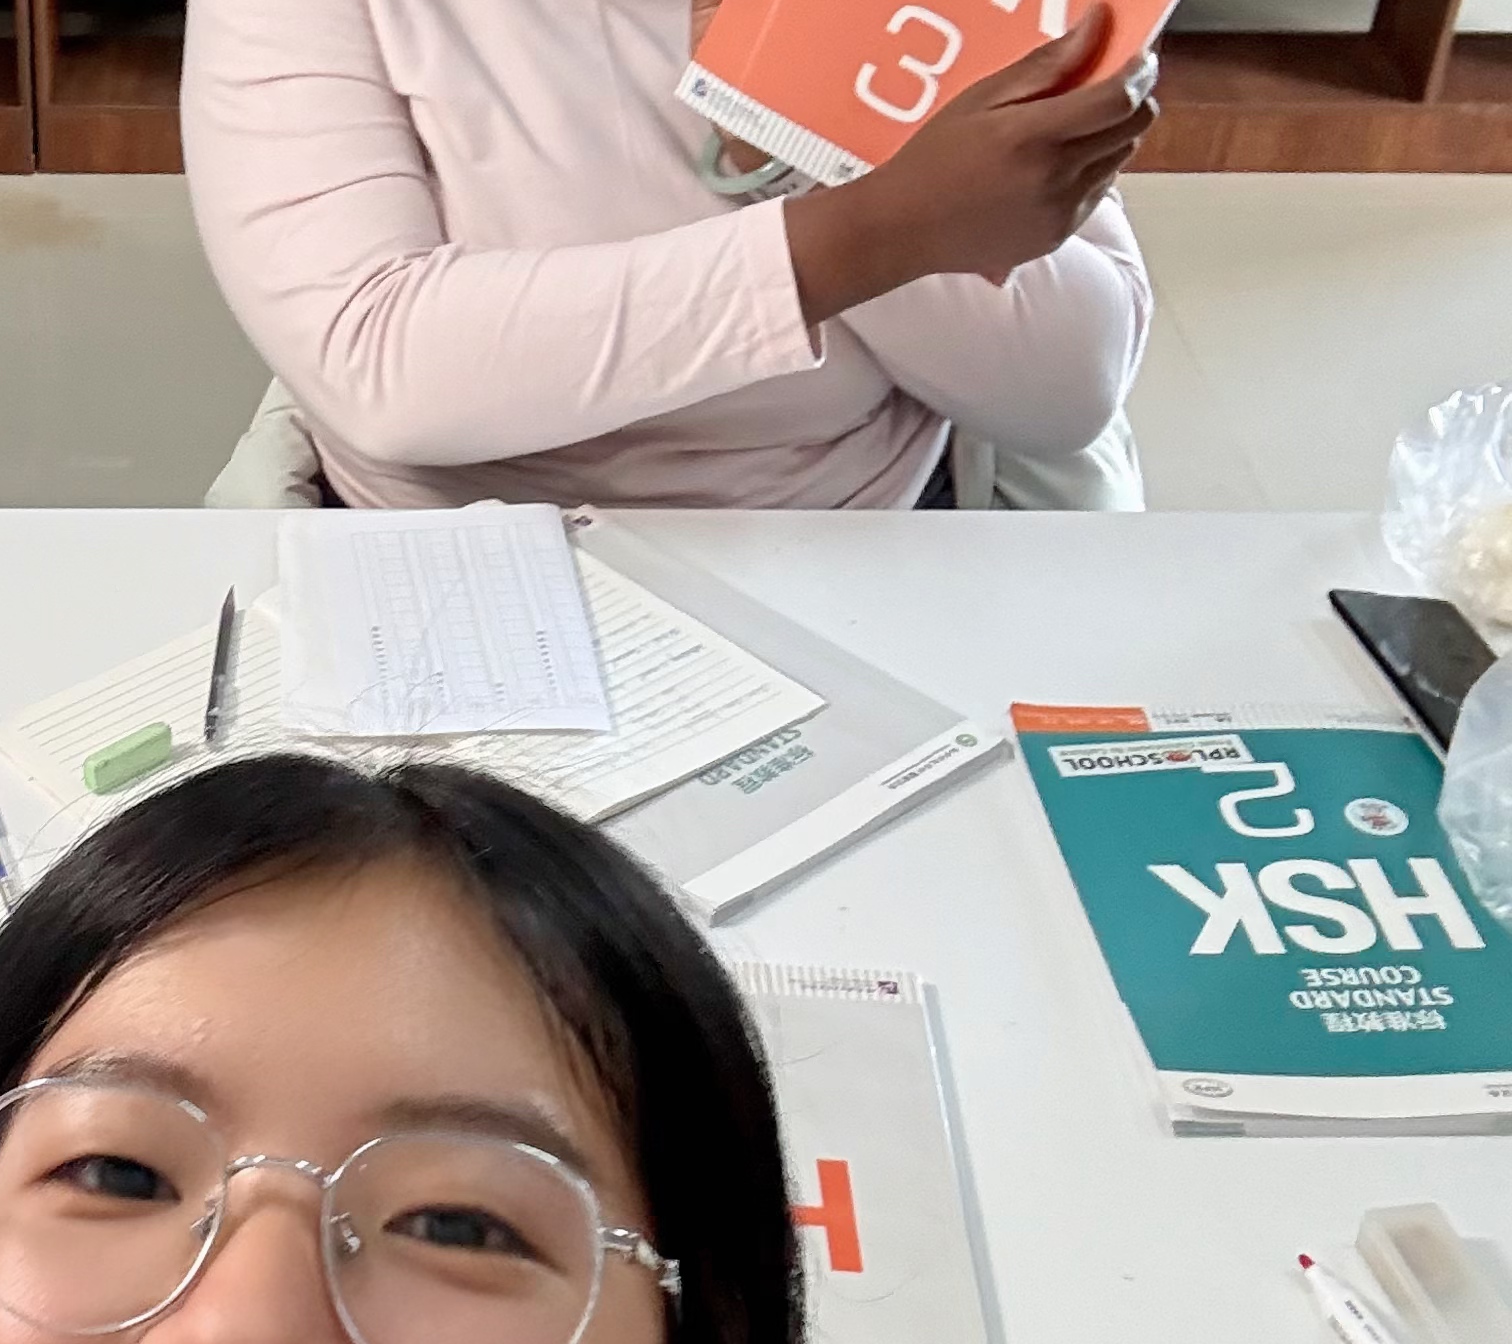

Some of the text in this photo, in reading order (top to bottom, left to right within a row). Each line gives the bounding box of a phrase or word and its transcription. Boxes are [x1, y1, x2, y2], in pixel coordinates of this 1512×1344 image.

[854, 3, 963, 124] 3
[1062, 752, 1164, 771] SCHOOL
[1202, 762, 1316, 838] 2
[1146, 857, 1487, 957] HSK
[1288, 985, 1456, 1010] STANDARD
[1299, 964, 1423, 988] COURSE
